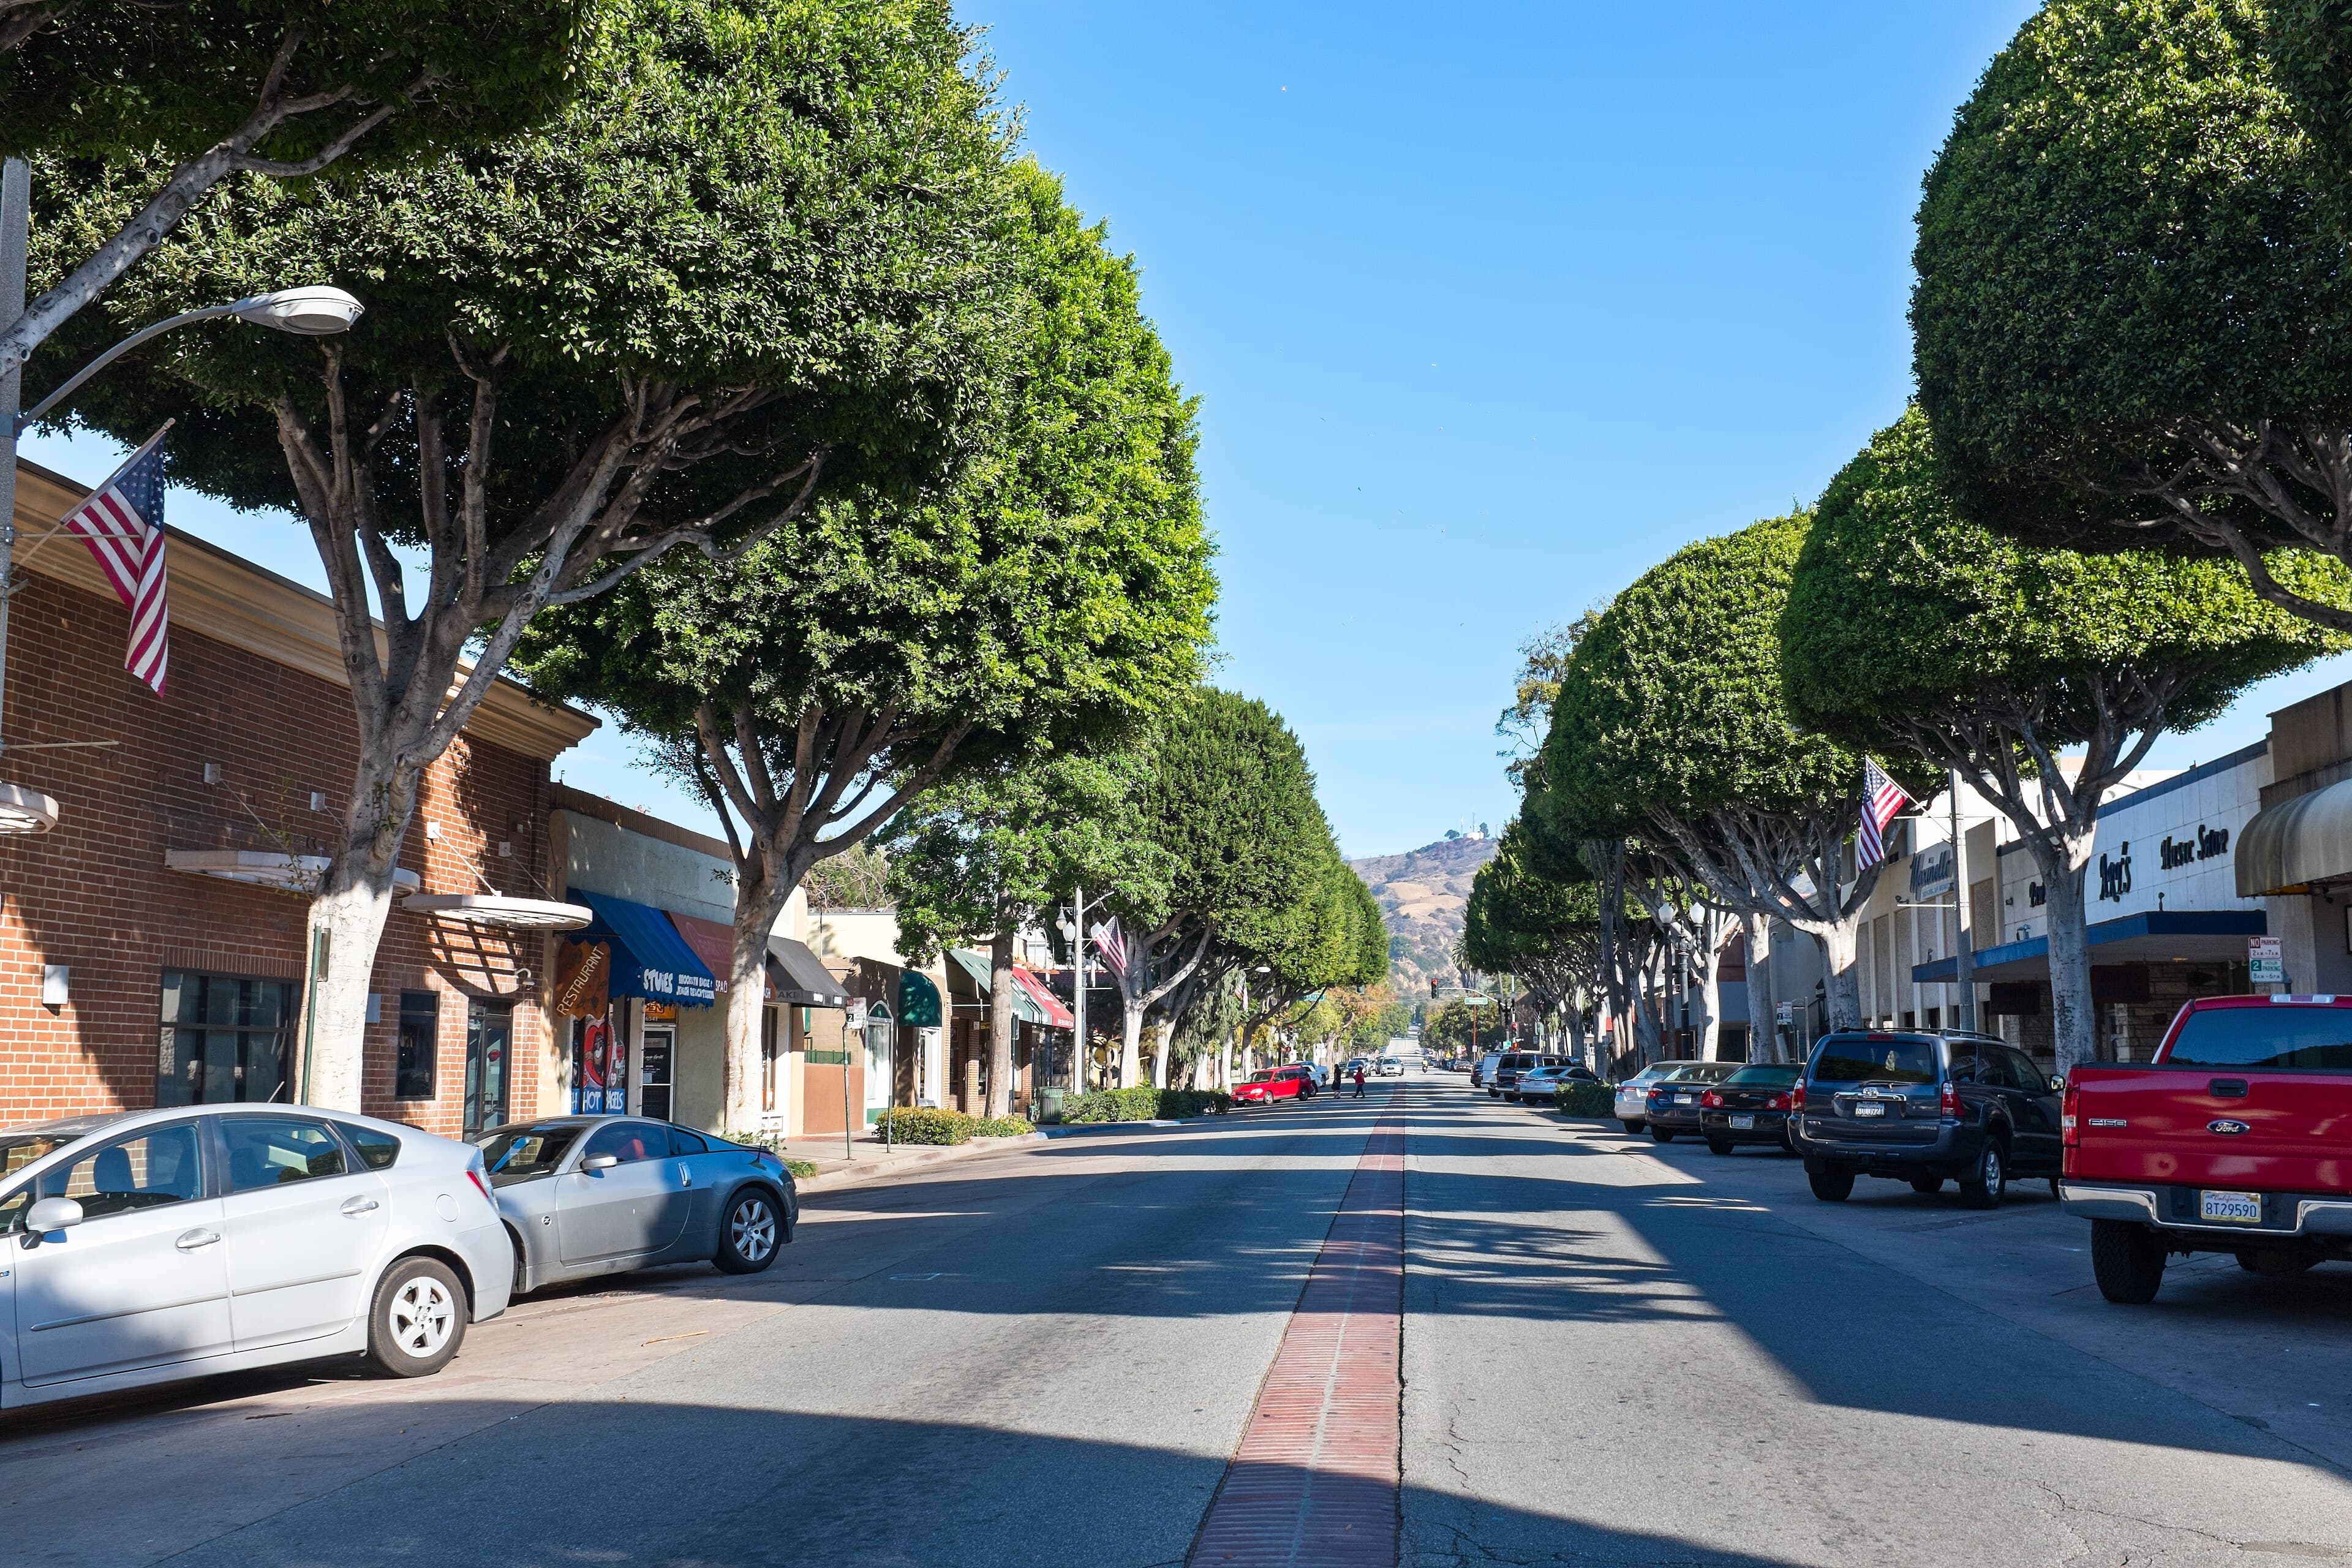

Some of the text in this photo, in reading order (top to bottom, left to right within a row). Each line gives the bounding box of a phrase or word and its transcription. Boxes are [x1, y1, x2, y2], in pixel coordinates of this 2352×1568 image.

[2250, 938, 2260, 947] NO
[2253, 961, 2259, 970] 2
[557, 946, 605, 1015] RESTAURANT
[583, 1090, 601, 1112] HOT
[2215, 1122, 2239, 1132] Ford
[2214, 1194, 2250, 1204] California
[2206, 1202, 2256, 1218] 8T29590
